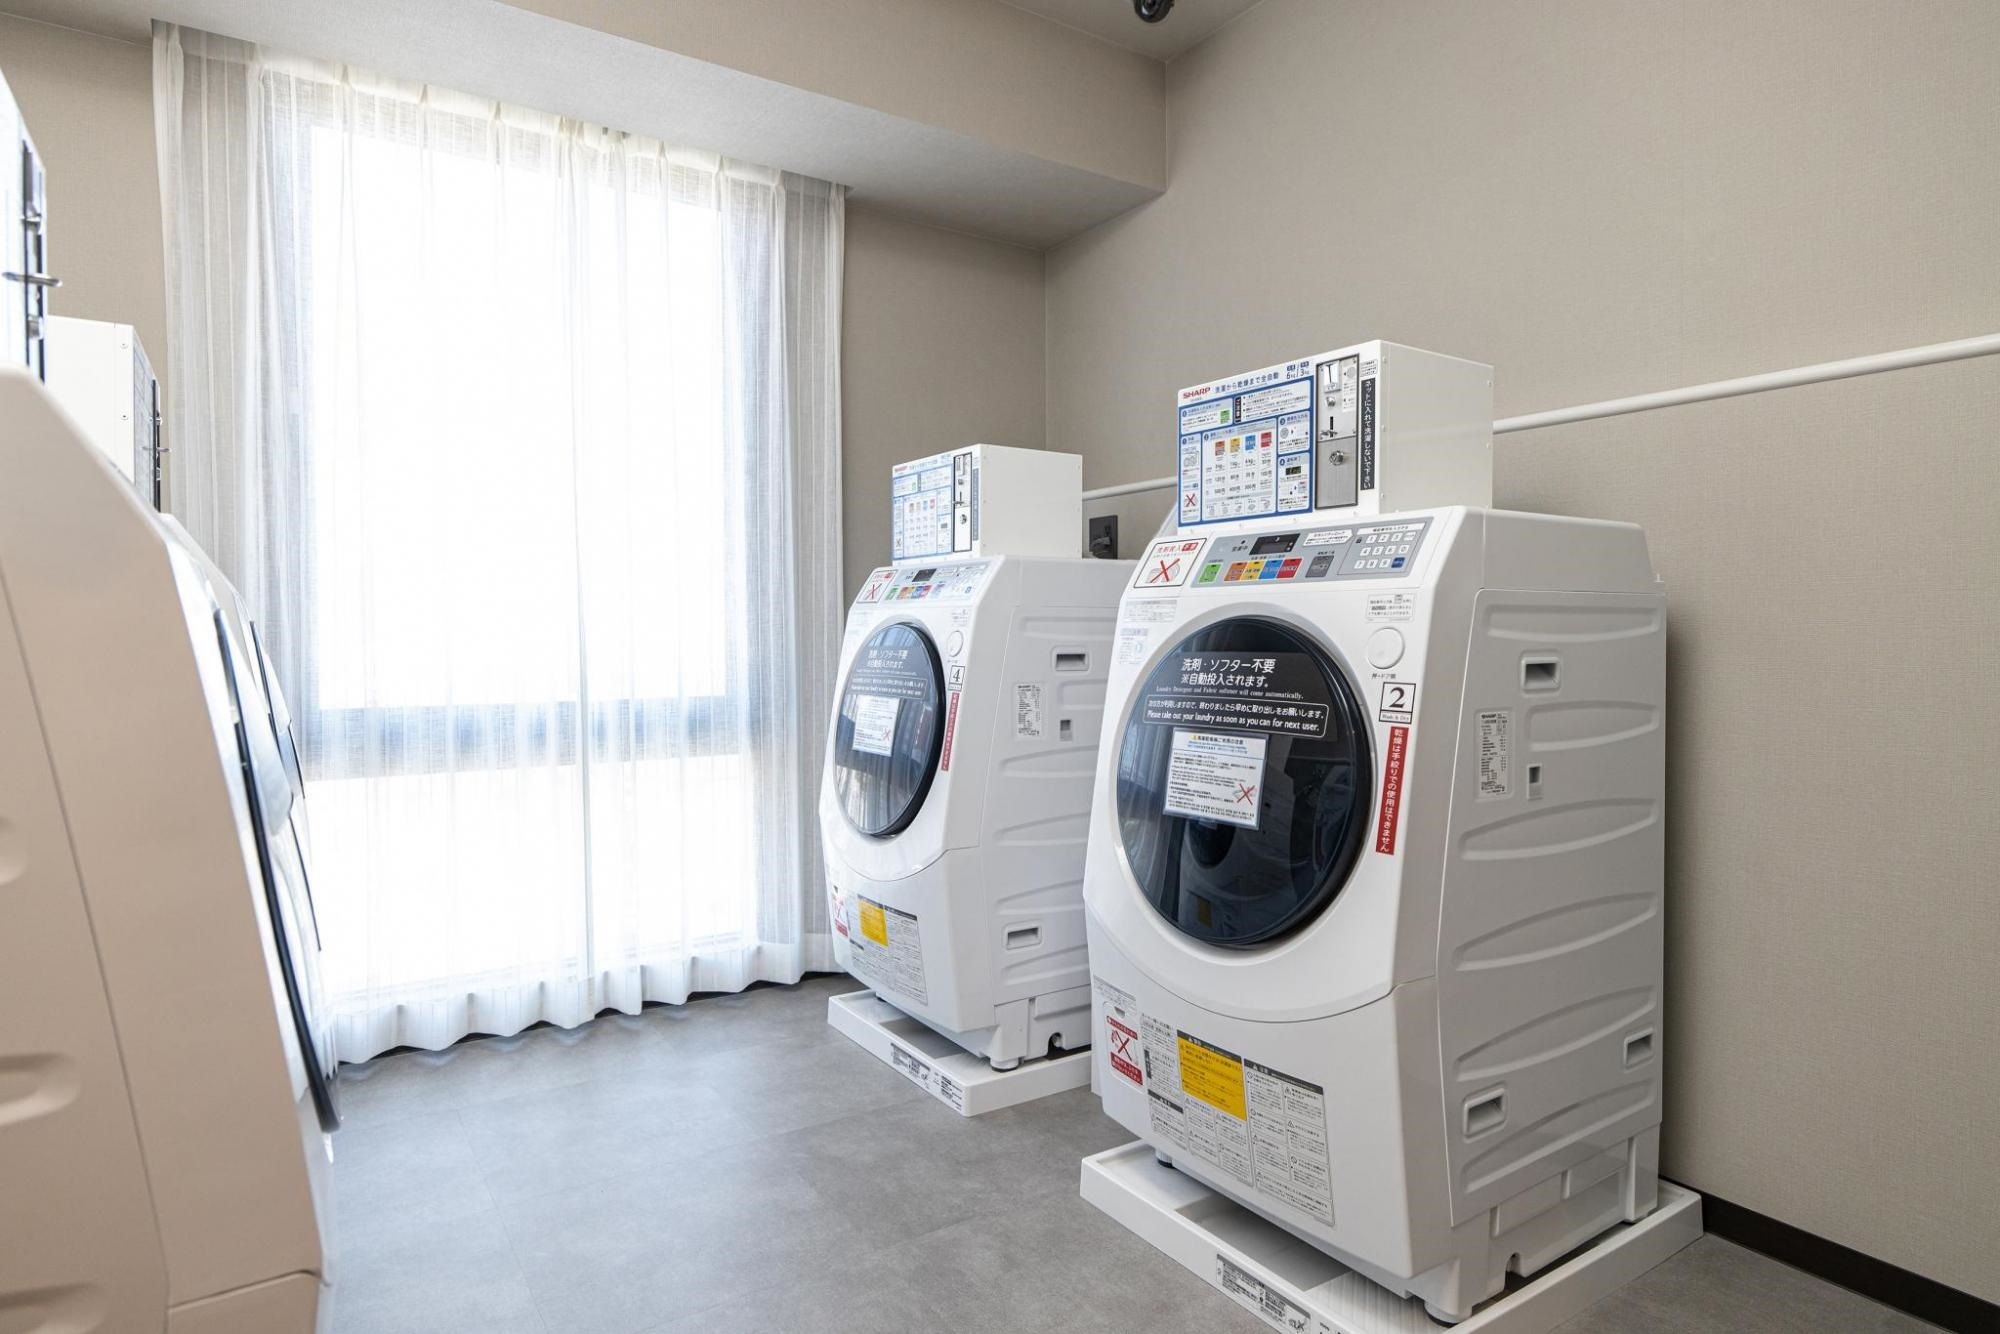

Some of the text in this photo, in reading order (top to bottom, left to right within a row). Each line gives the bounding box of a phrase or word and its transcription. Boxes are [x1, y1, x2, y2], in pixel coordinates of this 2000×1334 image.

[1182, 386, 1211, 399] SHARP
[1181, 658, 1276, 673] 洗剤・ソフター不要
[952, 668, 960, 682] 4
[1389, 687, 1405, 708] 2
[1147, 709, 1161, 718] Please
[1161, 710, 1172, 719] take
[1182, 713, 1195, 722] your
[1194, 712, 1215, 724] laundry
[1246, 718, 1259, 727] you
[1272, 717, 1283, 727] for
[1284, 721, 1301, 729] next
[1302, 723, 1320, 731] user.
